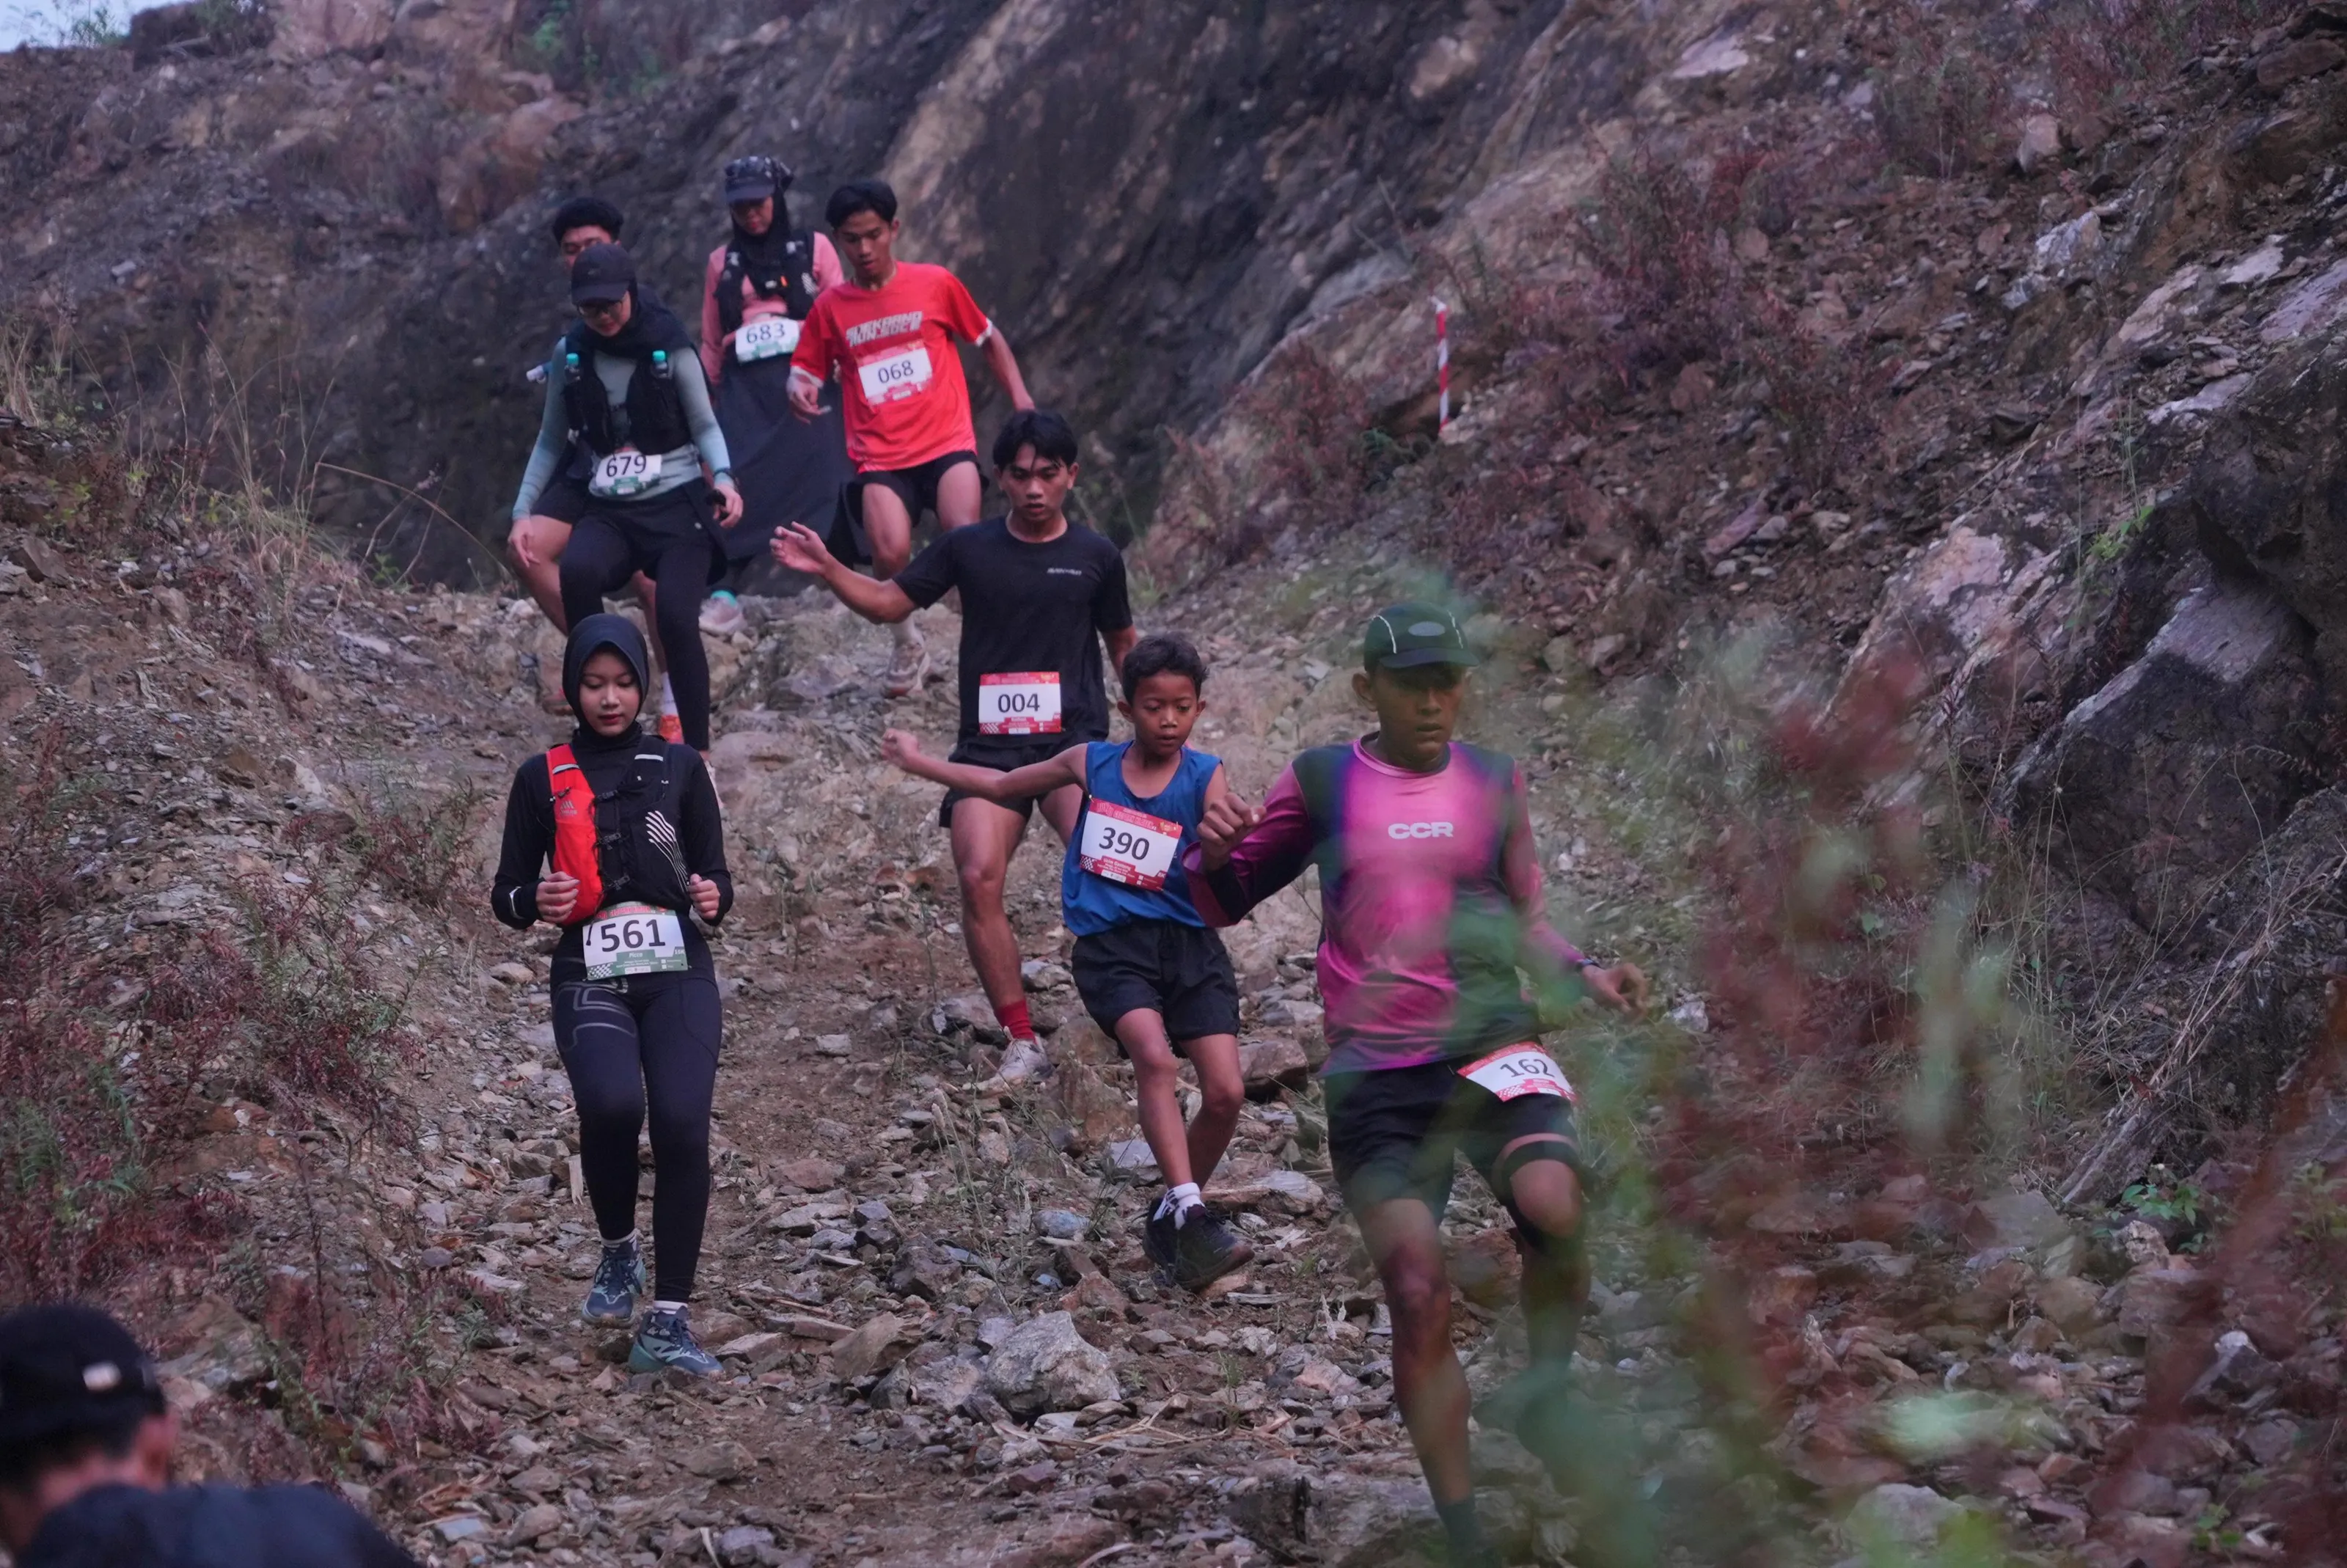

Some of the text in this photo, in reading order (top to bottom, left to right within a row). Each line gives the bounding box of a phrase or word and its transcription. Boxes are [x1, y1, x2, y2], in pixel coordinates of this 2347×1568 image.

[746, 323, 785, 343] 683
[877, 359, 914, 384] 068
[606, 454, 647, 477] 679
[997, 693, 1040, 713] 004
[1388, 821, 1454, 840] CCR
[1099, 827, 1150, 860] 390
[600, 918, 666, 952] 561
[1499, 1058, 1556, 1078] 162
